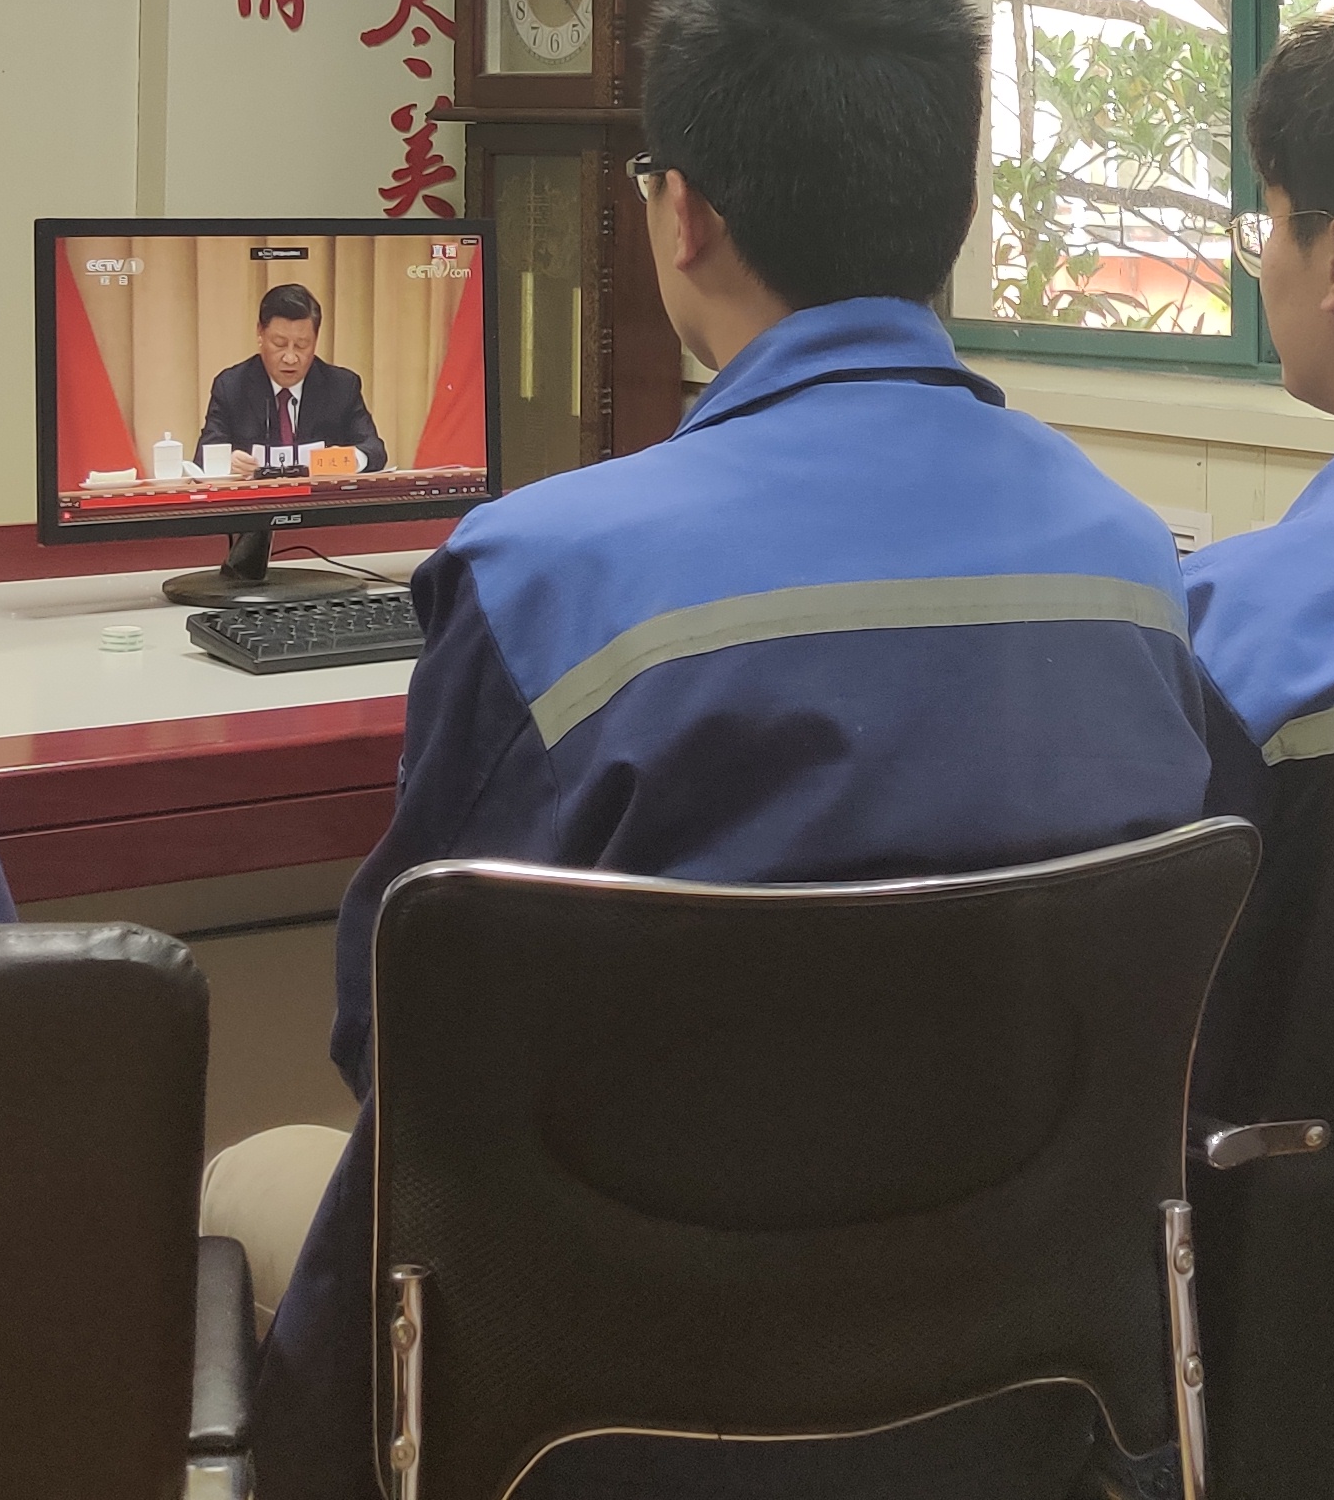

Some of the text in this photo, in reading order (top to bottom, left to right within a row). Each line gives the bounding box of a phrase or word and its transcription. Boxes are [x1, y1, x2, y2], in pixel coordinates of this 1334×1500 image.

[516, 1, 526, 21] 8
[530, 26, 540, 47] 7
[550, 32, 560, 53] 6
[570, 23, 581, 44] 5
[86, 259, 125, 272] CCTV
[271, 514, 302, 525] ASUS
